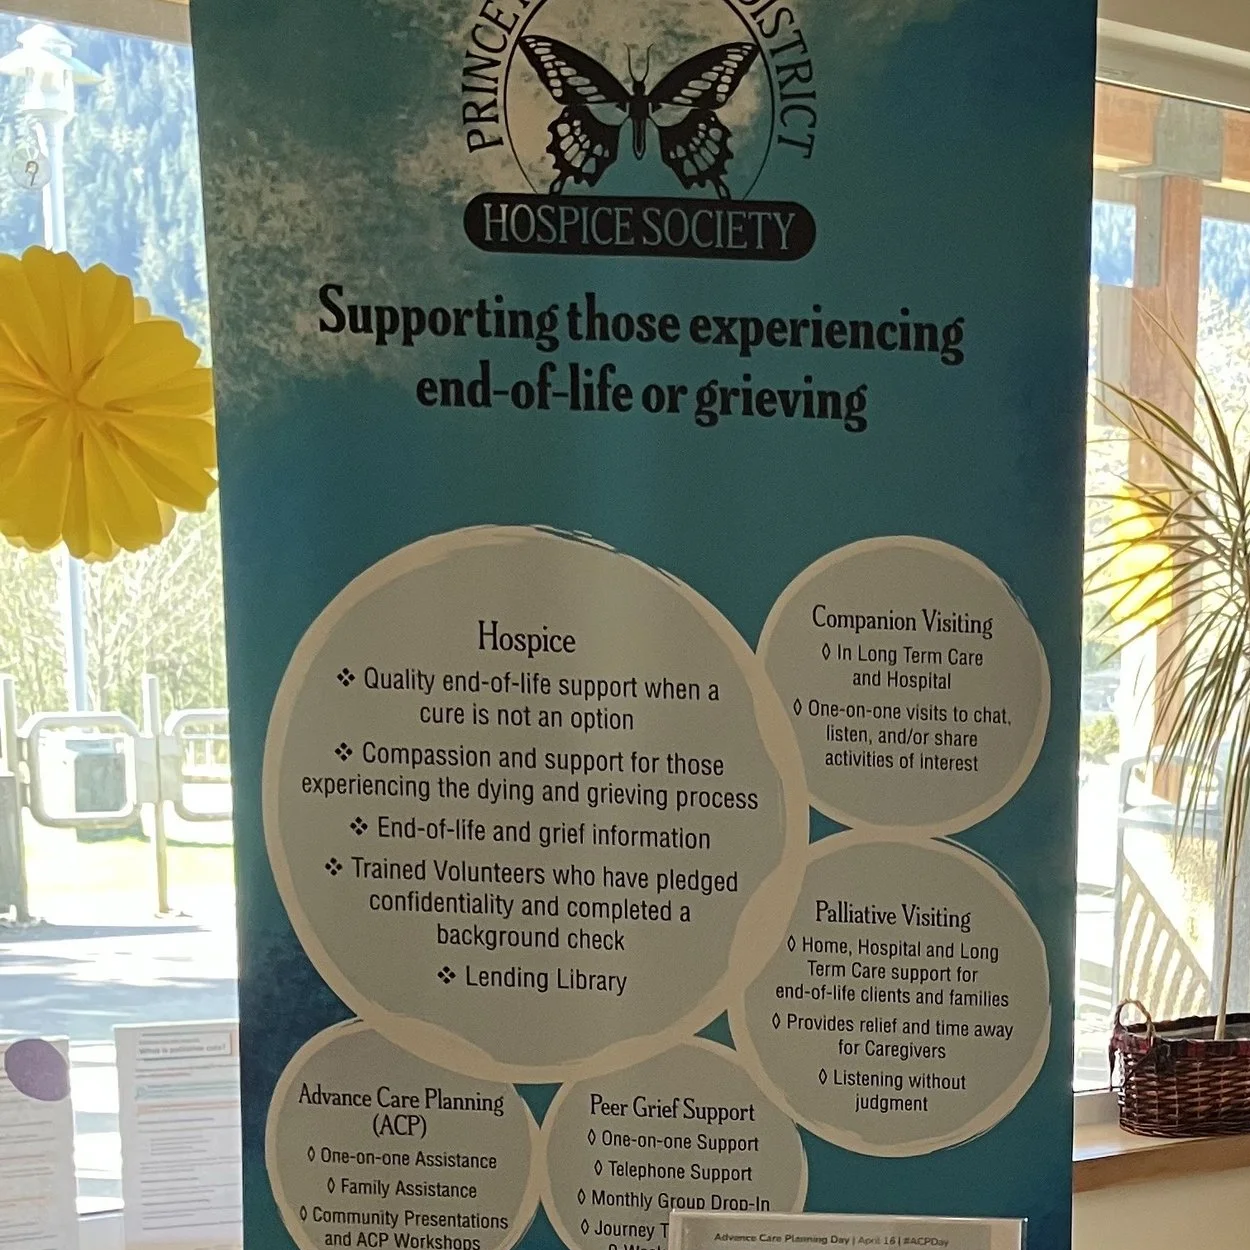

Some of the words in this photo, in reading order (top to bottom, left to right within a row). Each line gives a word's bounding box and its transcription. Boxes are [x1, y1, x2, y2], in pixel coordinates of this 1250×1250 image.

[461, 0, 520, 153] PRINCE
[746, 0, 817, 159] ISTRICT
[482, 201, 635, 248] HOSPICE
[641, 208, 796, 253] SOCIETY
[318, 283, 560, 352] Supporting
[568, 291, 681, 342] those
[689, 302, 965, 366] experiencing
[416, 359, 633, 412] end-of-life
[641, 382, 688, 414] or
[694, 372, 869, 433] grieving
[812, 604, 917, 634] Companion
[921, 609, 993, 639] Visiting
[478, 620, 577, 659] Hospice
[363, 666, 435, 696] Quality
[442, 671, 551, 696] end-of-life
[558, 675, 638, 702] support
[643, 678, 700, 700] when
[707, 683, 720, 701] a
[808, 699, 901, 720] One-on-one
[906, 703, 947, 721] visits
[953, 706, 968, 723] to
[973, 706, 1012, 726] chat,
[377, 815, 486, 842] End-of-life
[492, 820, 531, 843] and
[538, 822, 586, 849] grief
[592, 823, 711, 850] information
[815, 900, 897, 925] Palliative
[901, 903, 971, 933] Visiting
[787, 1013, 854, 1032] Provides
[859, 1016, 898, 1034] relief
[902, 1019, 930, 1035] and
[935, 1020, 969, 1037] time
[974, 1023, 1014, 1041] away
[298, 1082, 372, 1107] Advance
[377, 1086, 420, 1109] Care
[425, 1088, 505, 1116] Planning
[590, 1093, 628, 1116] Peer
[633, 1095, 679, 1119] Grief
[683, 1098, 755, 1125] Support
[373, 1113, 427, 1139] (ACP)
[592, 1190, 653, 1211] Monthly
[658, 1192, 705, 1209] Group
[711, 1195, 770, 1211] Drop-In
[594, 1219, 655, 1240] Journey
[714, 1232, 756, 1242] Advance
[759, 1233, 782, 1243] Care
[784, 1234, 828, 1246] Planning
[830, 1236, 850, 1247] Day
